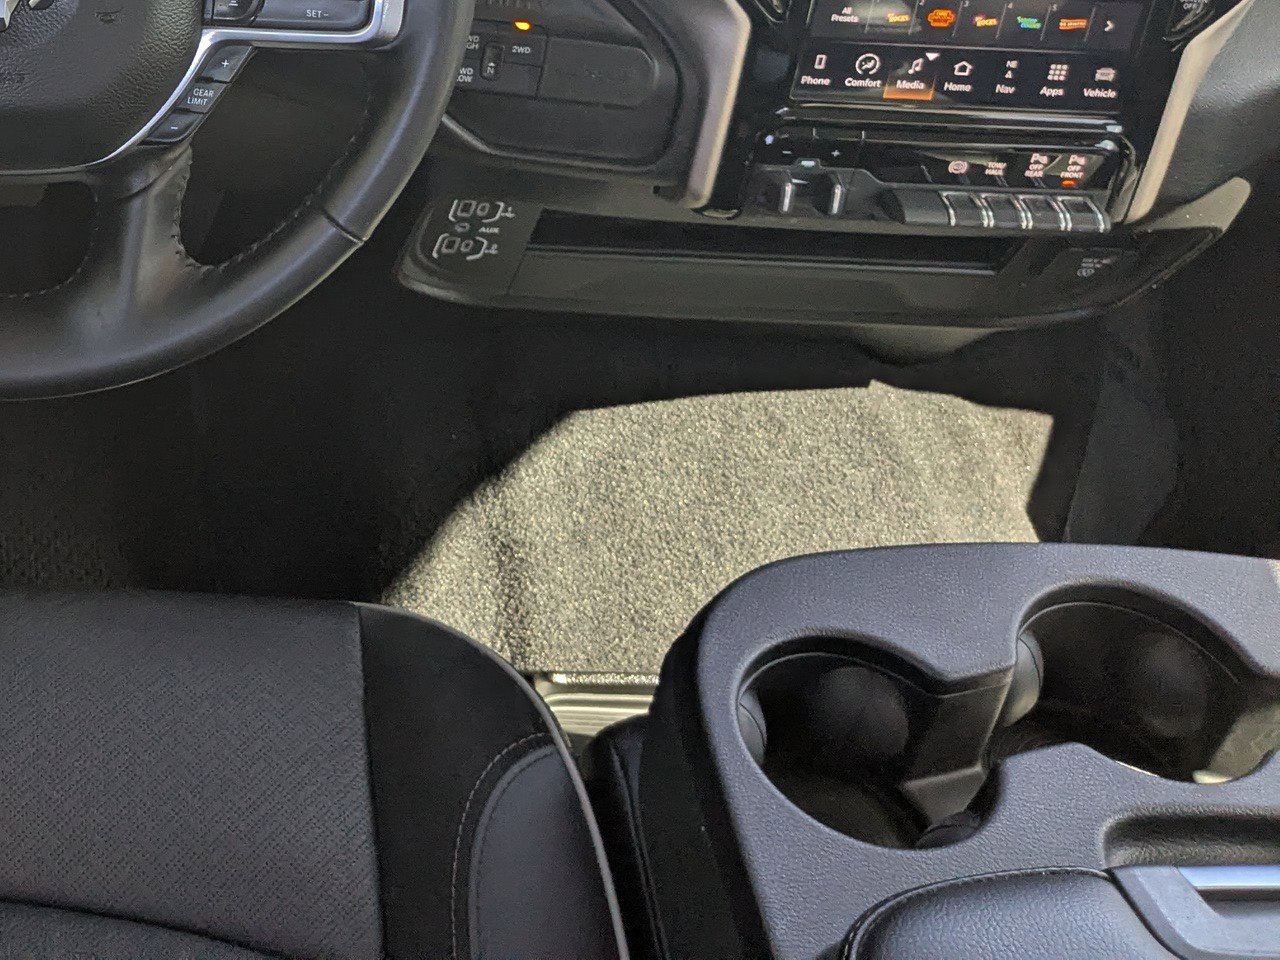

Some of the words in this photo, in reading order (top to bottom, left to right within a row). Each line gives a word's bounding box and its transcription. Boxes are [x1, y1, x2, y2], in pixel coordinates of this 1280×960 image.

[842, 6, 853, 15] All
[831, 14, 859, 23] Presets
[511, 45, 531, 54] 2WD
[486, 66, 494, 74] N
[801, 75, 831, 86] Phone
[844, 78, 882, 88] Comfort
[896, 80, 926, 90] Media
[944, 82, 972, 92] Home
[995, 84, 1015, 94] Nav
[1039, 86, 1065, 97] Apps
[193, 87, 214, 97] GEAR
[1083, 88, 1117, 99] Vehicle
[187, 97, 208, 107] LIMIT
[1028, 163, 1044, 171] OFF
[985, 168, 1004, 176] HAUL
[1024, 170, 1044, 178] REAR
[1060, 171, 1084, 179] FRONT
[478, 226, 500, 234] AUX
